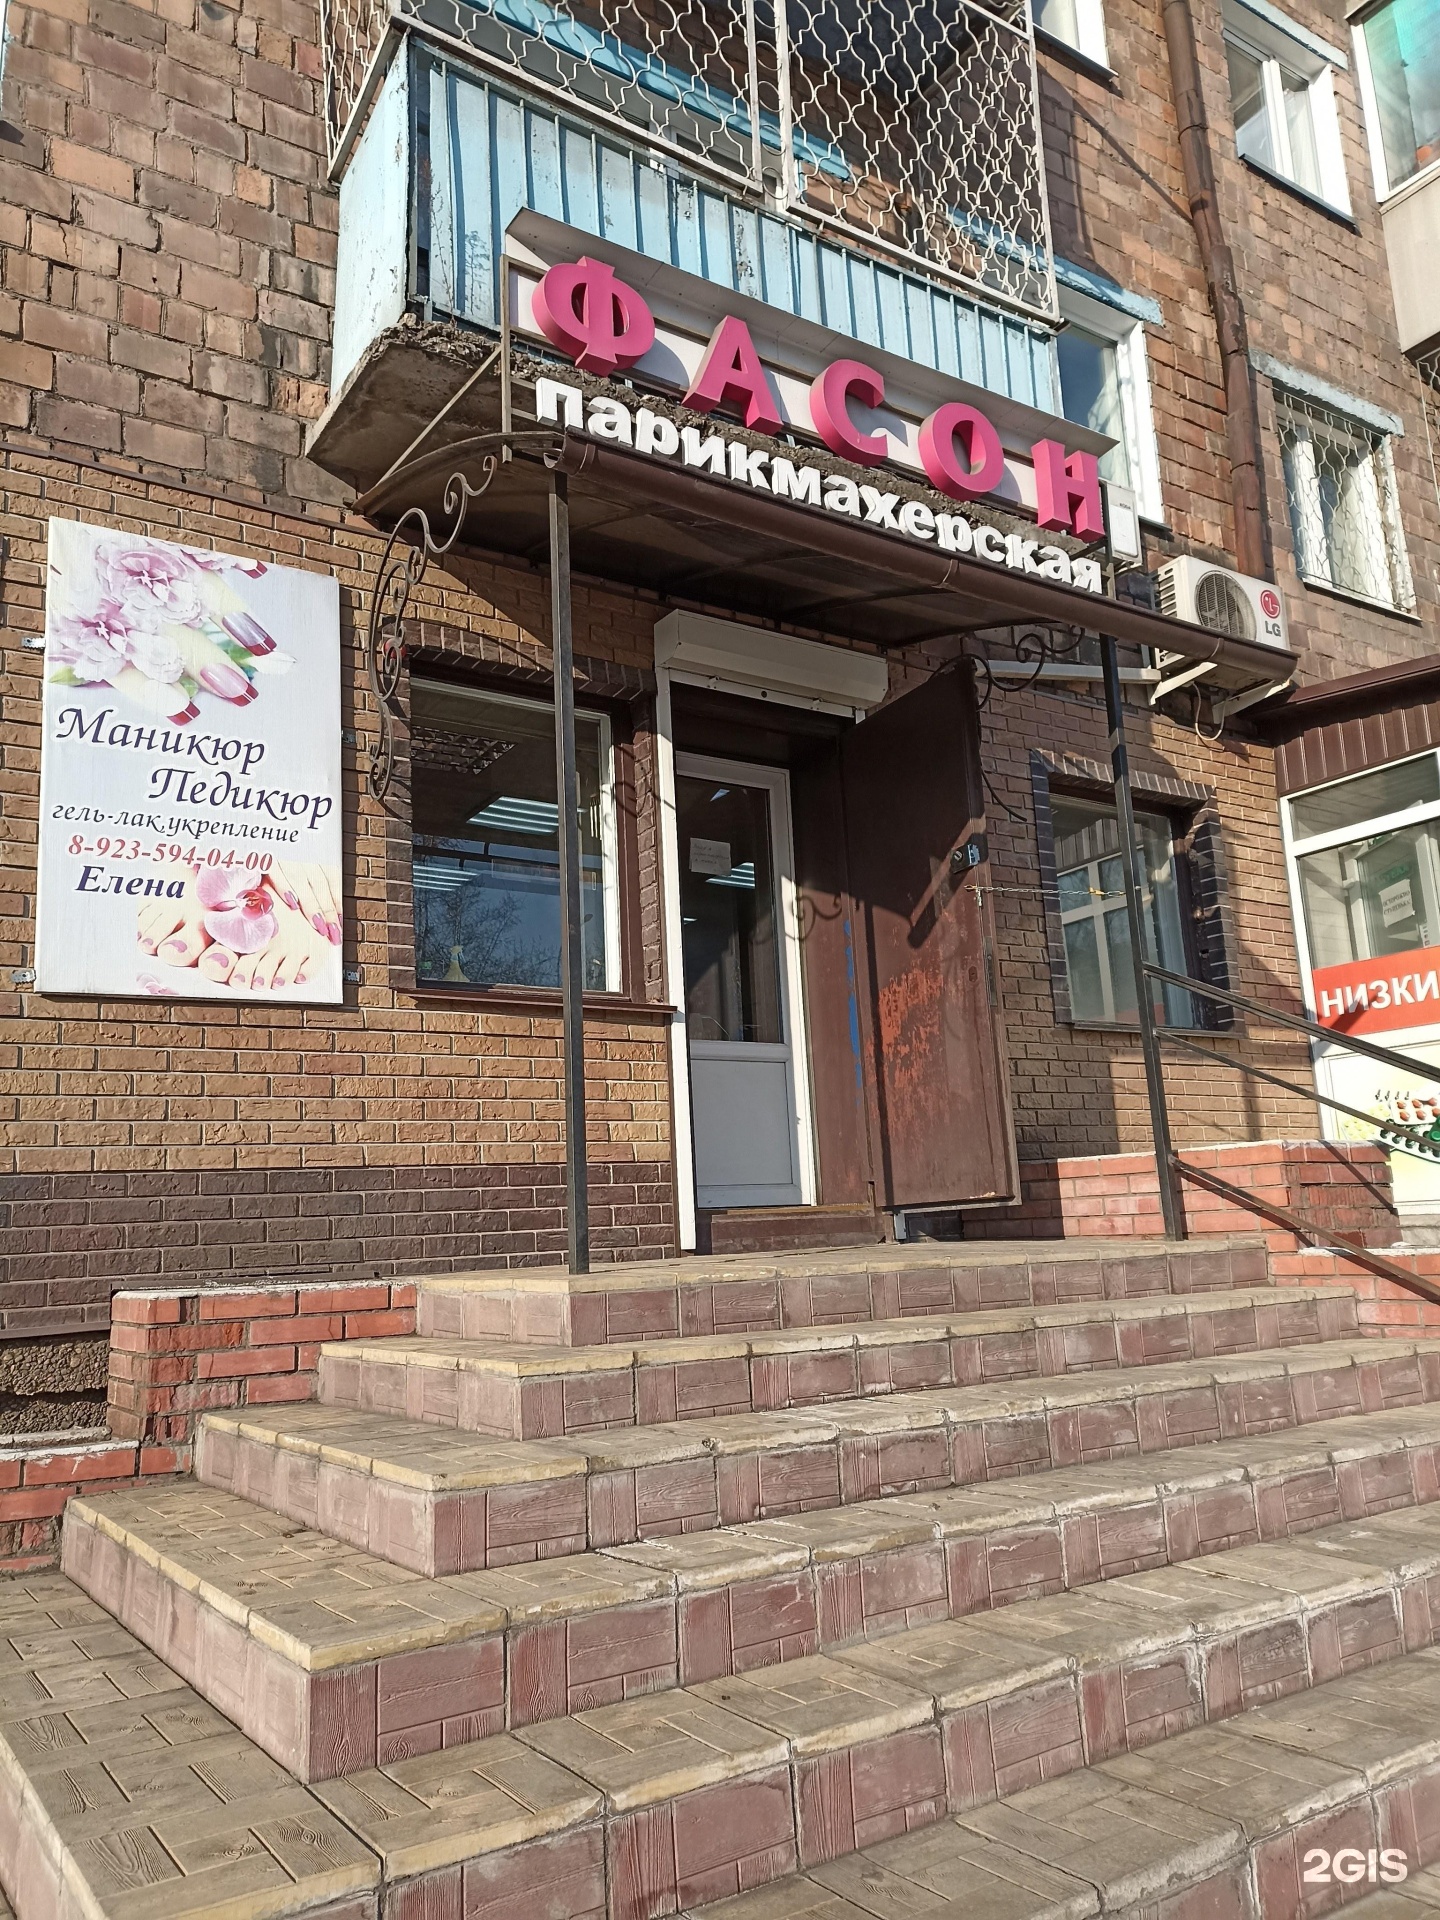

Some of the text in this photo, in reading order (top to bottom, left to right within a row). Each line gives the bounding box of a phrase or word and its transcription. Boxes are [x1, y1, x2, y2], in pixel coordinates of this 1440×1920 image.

[532, 256, 1105, 543] ФАСОН
[536, 377, 1102, 594] парикмахерская
[1265, 620, 1281, 637] LG
[56, 708, 265, 775] Маникюр
[149, 768, 332, 829] Педикюр
[68, 834, 274, 872] 8-923-594-04-00
[75, 865, 186, 899] Елена
[1321, 970, 1440, 1018] НИЗКИ
